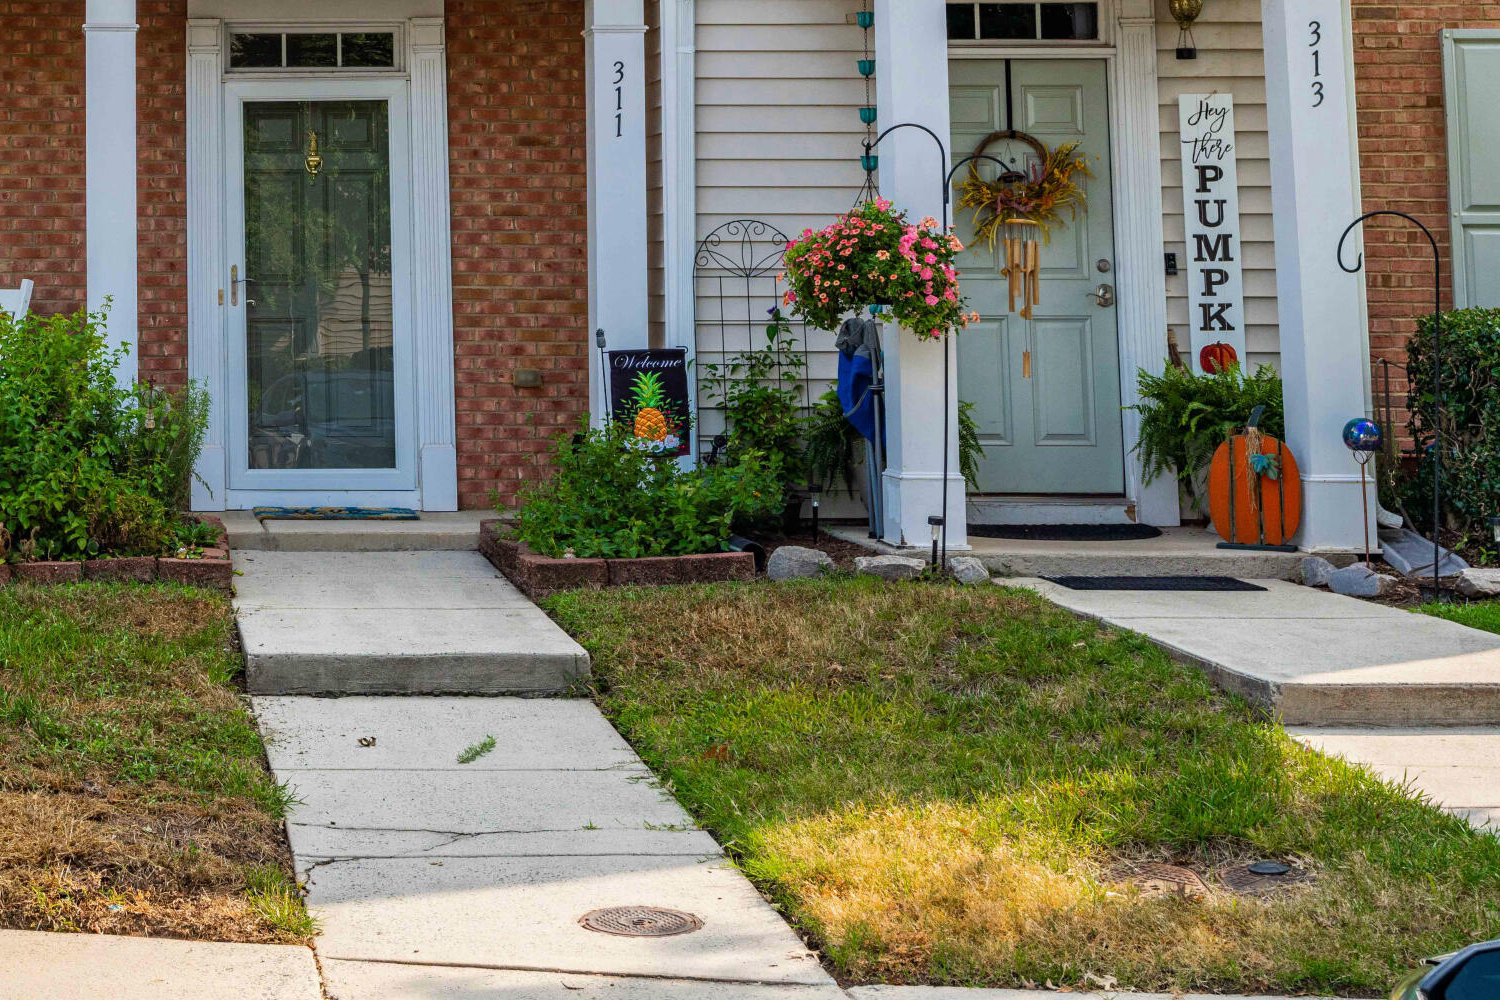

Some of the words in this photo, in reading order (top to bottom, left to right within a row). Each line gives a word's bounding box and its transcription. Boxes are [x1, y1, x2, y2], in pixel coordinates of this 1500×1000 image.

[1308, 20, 1325, 108] 313
[612, 60, 625, 138] 311
[1187, 100, 1230, 133] Hey
[1181, 132, 1233, 164] there
[614, 354, 682, 370] Welcome
